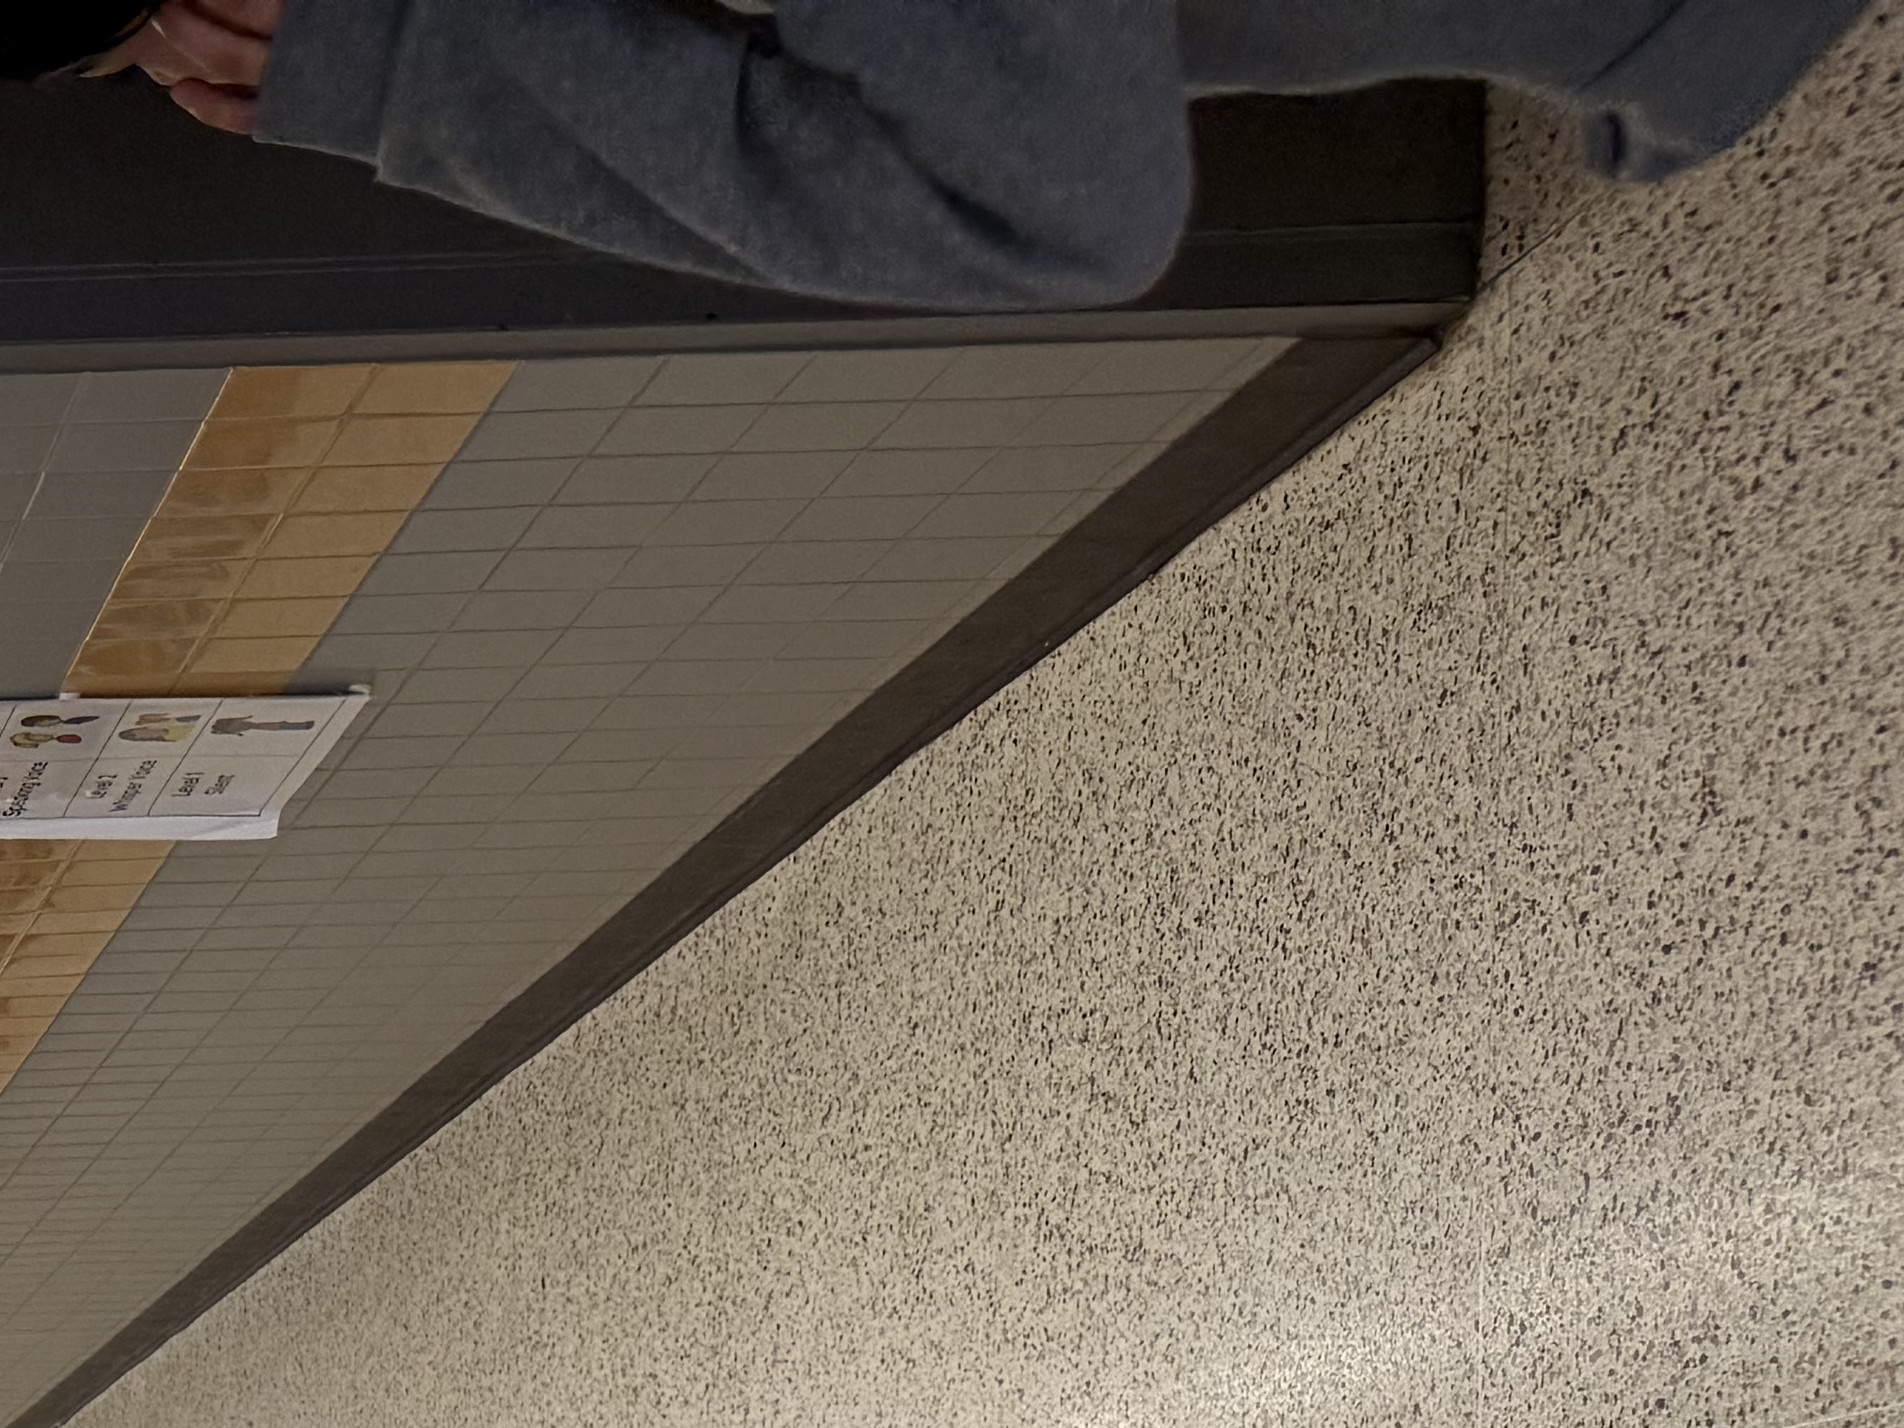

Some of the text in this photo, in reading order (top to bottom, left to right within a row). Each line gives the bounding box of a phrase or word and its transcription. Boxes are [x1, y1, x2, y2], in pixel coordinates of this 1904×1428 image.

[84, 781, 112, 798] Level
[171, 778, 199, 796] Level
[2, 783, 41, 816] Speaking
